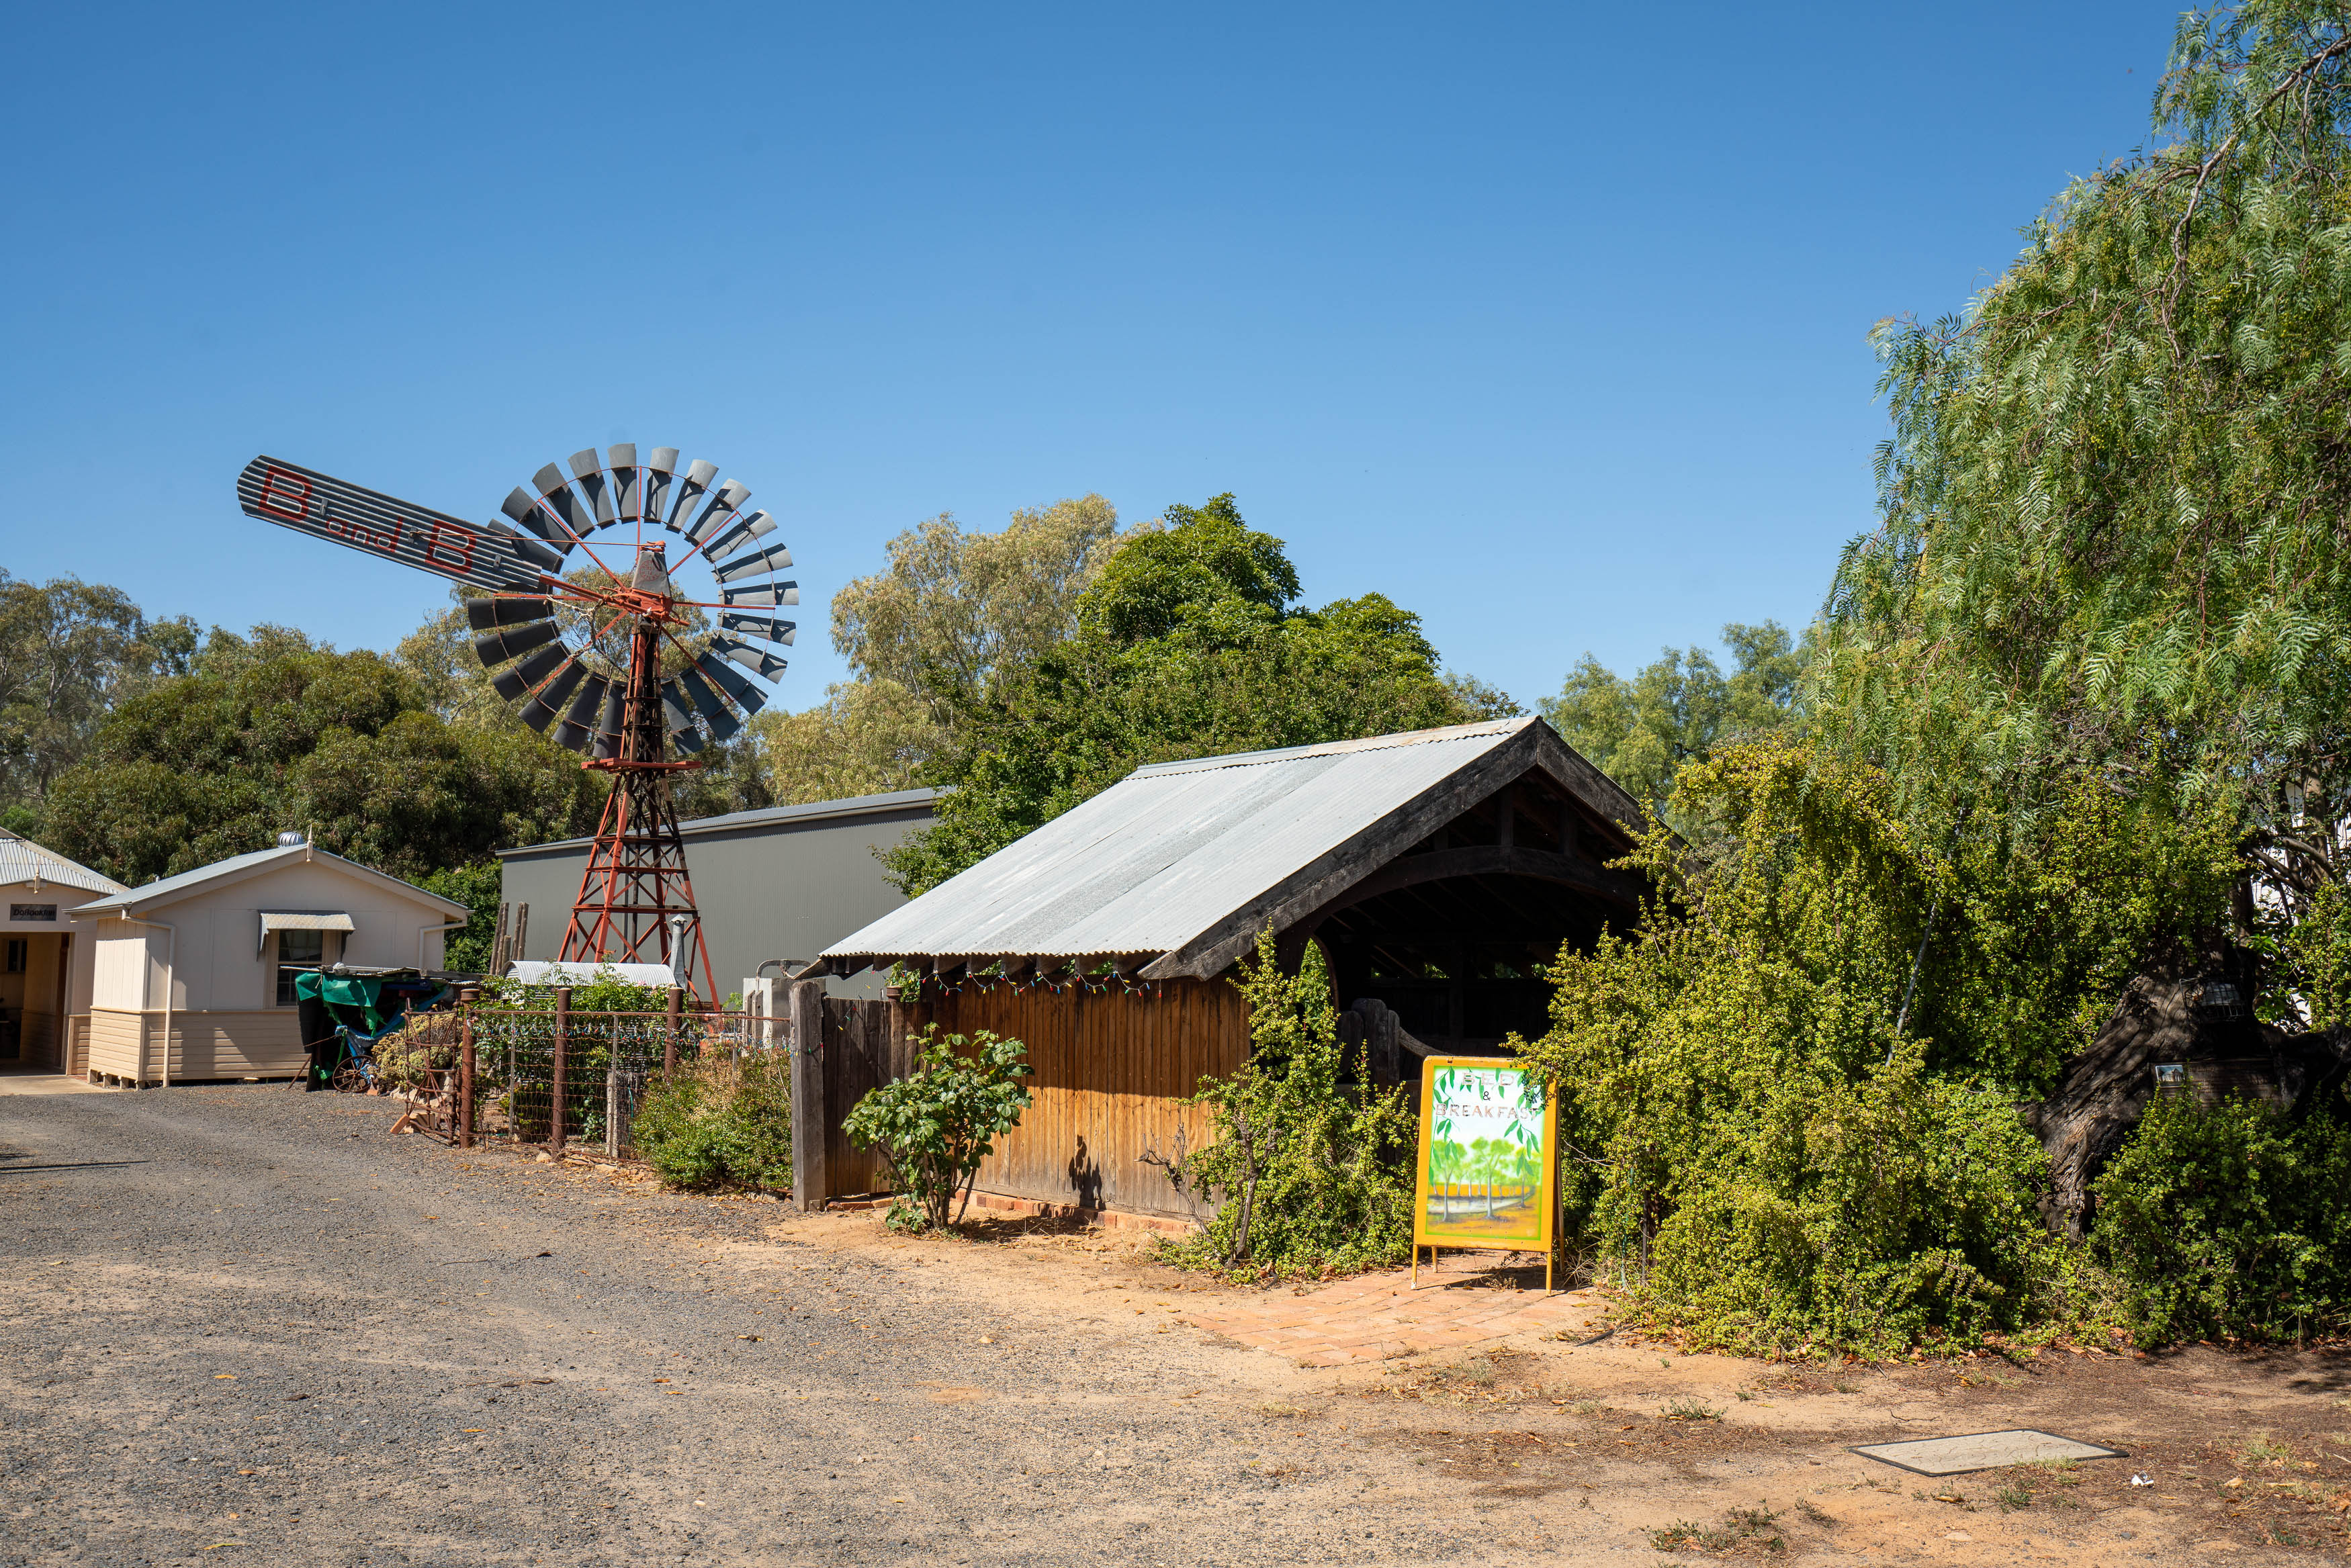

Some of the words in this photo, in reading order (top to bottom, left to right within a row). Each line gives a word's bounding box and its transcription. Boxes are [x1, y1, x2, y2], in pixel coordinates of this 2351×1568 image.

[258, 465, 313, 522] B
[326, 516, 404, 553] and
[425, 519, 477, 573] B
[1462, 1072, 1514, 1086] BED
[1482, 1091, 1491, 1101] &
[1435, 1103, 1540, 1119] BREAKFAST
